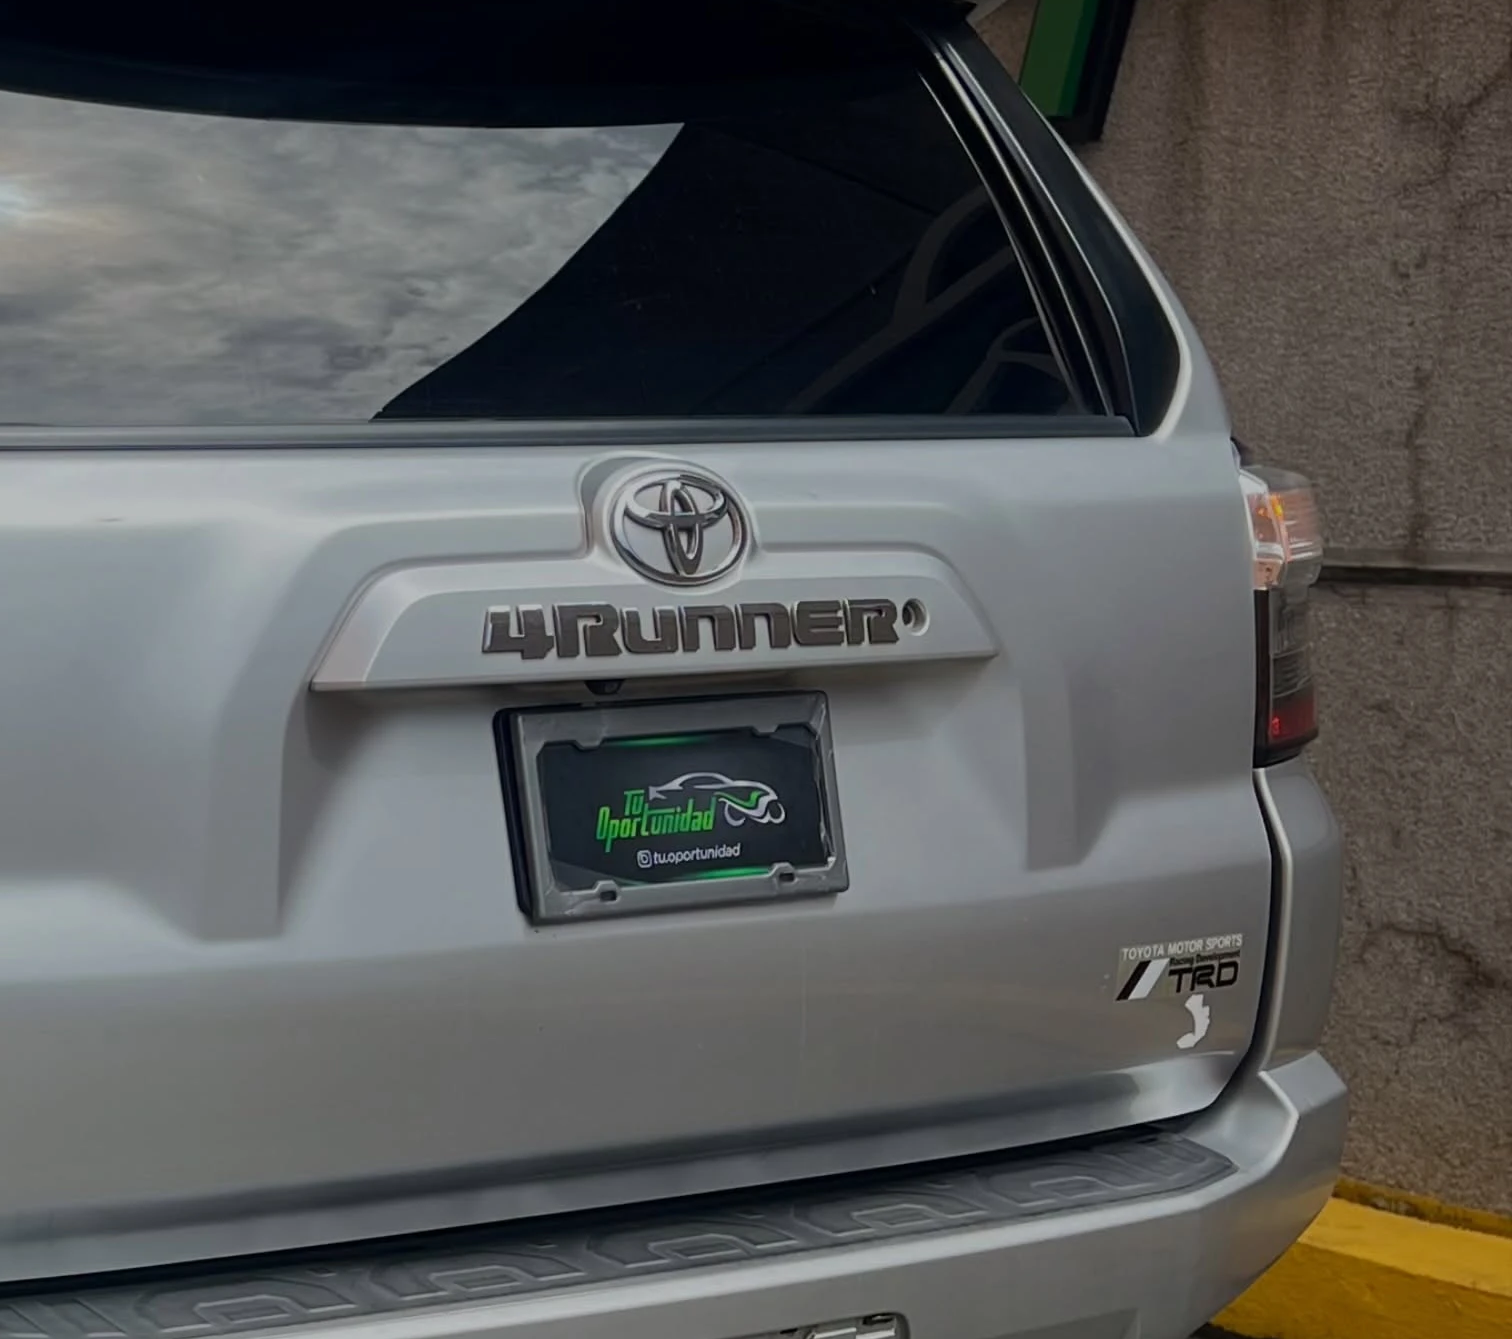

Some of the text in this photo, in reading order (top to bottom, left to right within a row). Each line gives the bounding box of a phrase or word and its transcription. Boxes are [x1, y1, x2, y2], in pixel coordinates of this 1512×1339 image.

[595, 795, 717, 853] Oportunidad
[1122, 933, 1243, 960] TOYOTA MOTOR SPORTS
[1168, 960, 1239, 993] TRD
